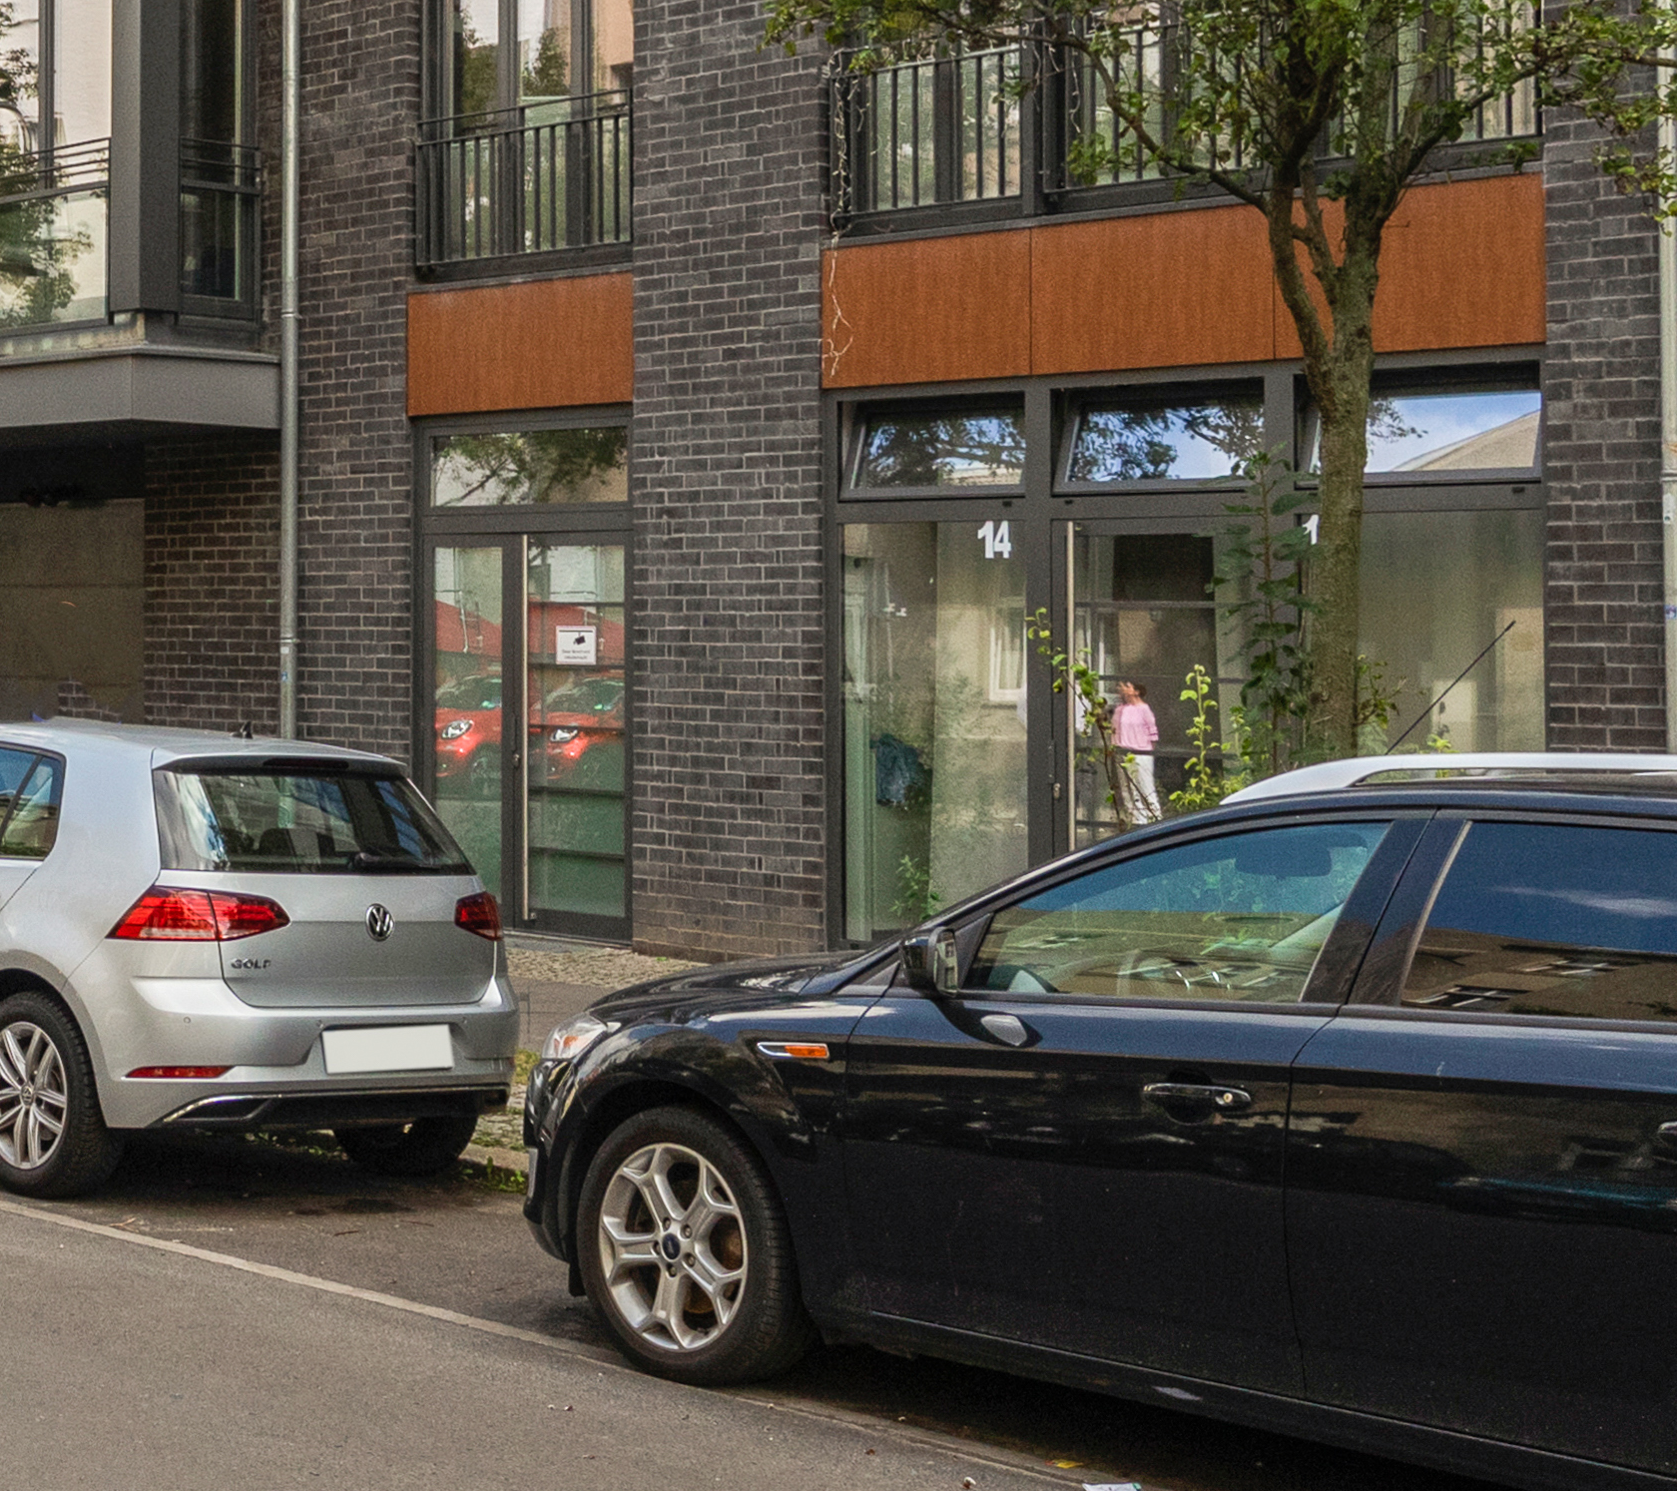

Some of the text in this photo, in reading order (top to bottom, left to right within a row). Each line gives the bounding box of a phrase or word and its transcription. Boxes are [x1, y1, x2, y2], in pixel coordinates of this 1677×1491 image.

[977, 520, 1012, 559] 14
[1302, 514, 1320, 546] 1
[231, 959, 272, 970] GOLF
